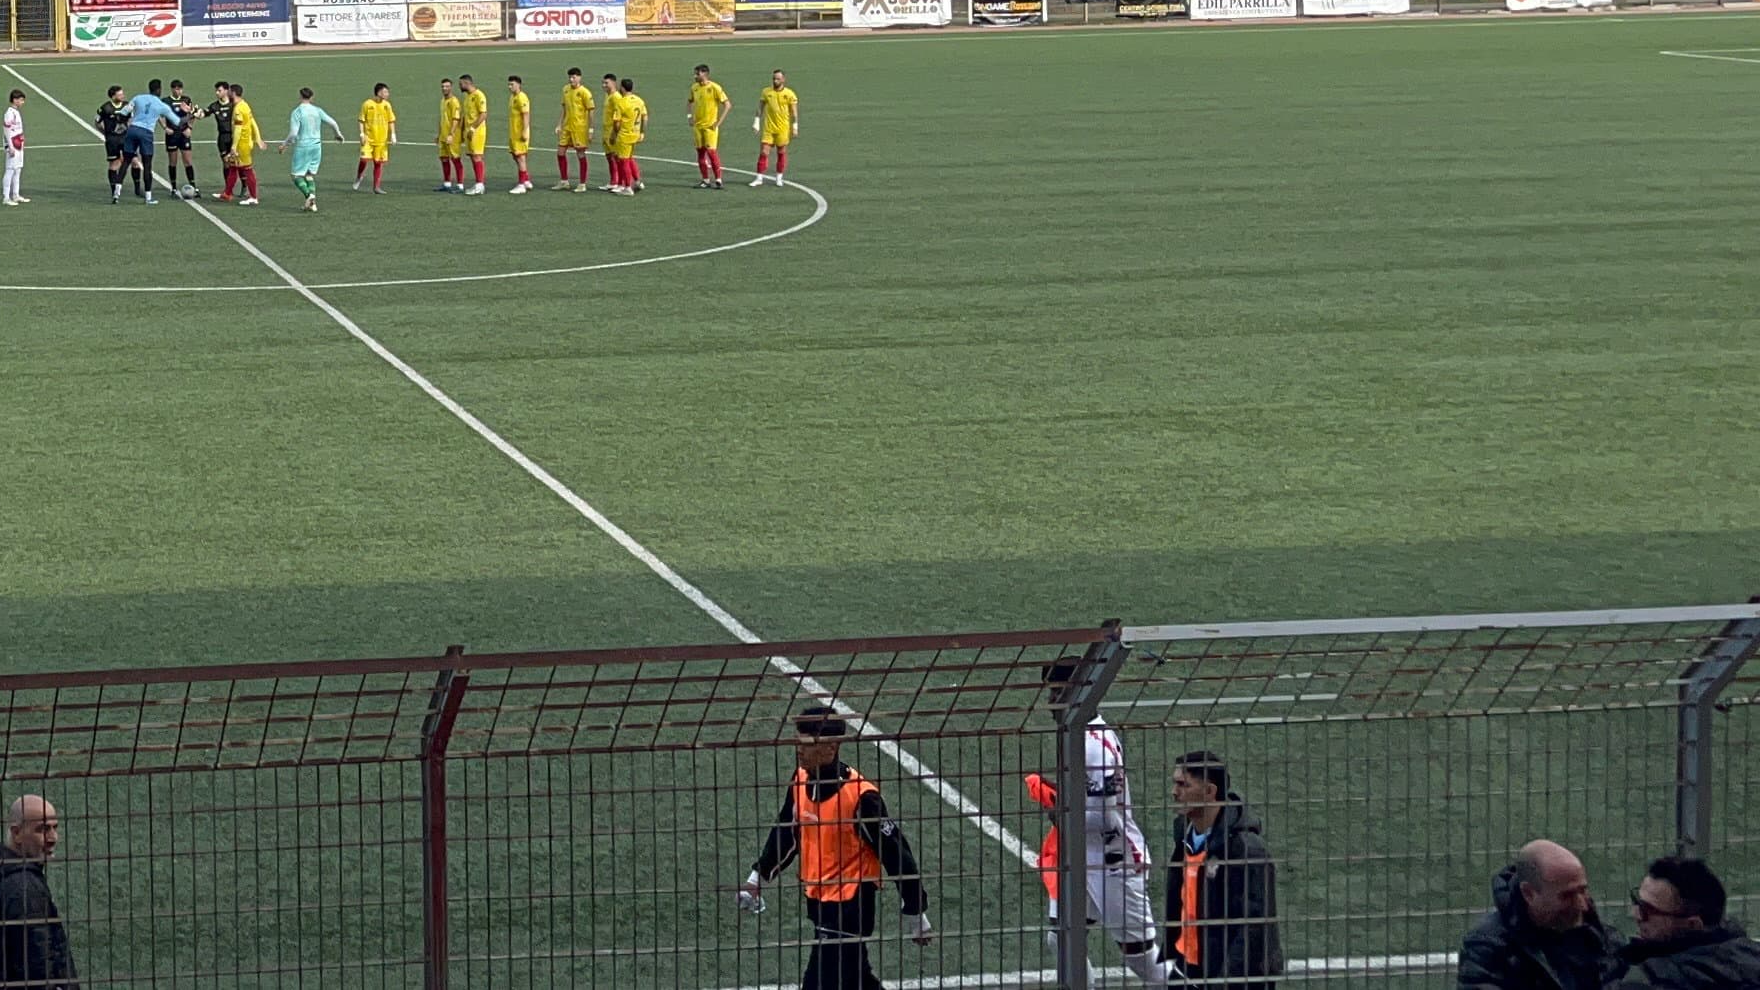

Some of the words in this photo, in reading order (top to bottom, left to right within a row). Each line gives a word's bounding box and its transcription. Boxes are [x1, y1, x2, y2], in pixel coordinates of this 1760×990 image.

[211, 11, 236, 19] LUNGO
[238, 10, 271, 18] TERMINE
[320, 13, 353, 21] ETTORE
[523, 10, 594, 27] CORINO
